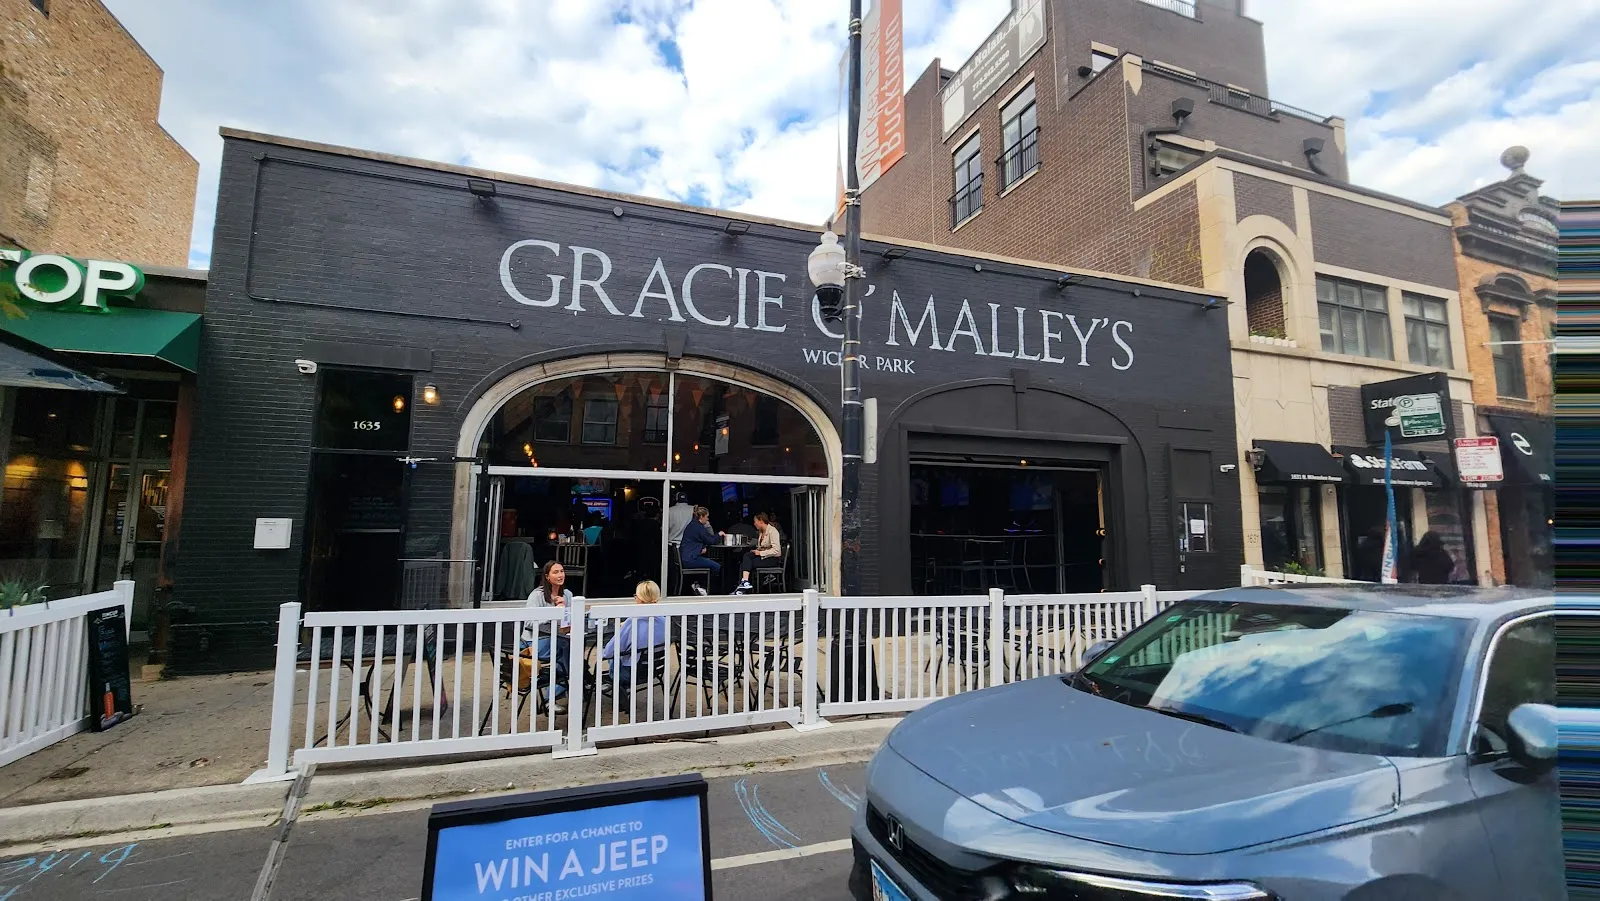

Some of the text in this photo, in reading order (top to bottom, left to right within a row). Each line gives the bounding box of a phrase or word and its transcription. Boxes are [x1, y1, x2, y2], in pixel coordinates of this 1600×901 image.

[879, 12, 901, 160] Bucktown
[499, 239, 788, 333] GRACIE
[876, 356, 916, 374] PARK
[352, 420, 381, 431] 1635
[505, 820, 643, 850] ENTER FOR A CHANCE TO
[474, 834, 669, 895] WIN A JEEP
[555, 879, 616, 900] EXCLUSIVE
[618, 873, 654, 890] PRIZES
